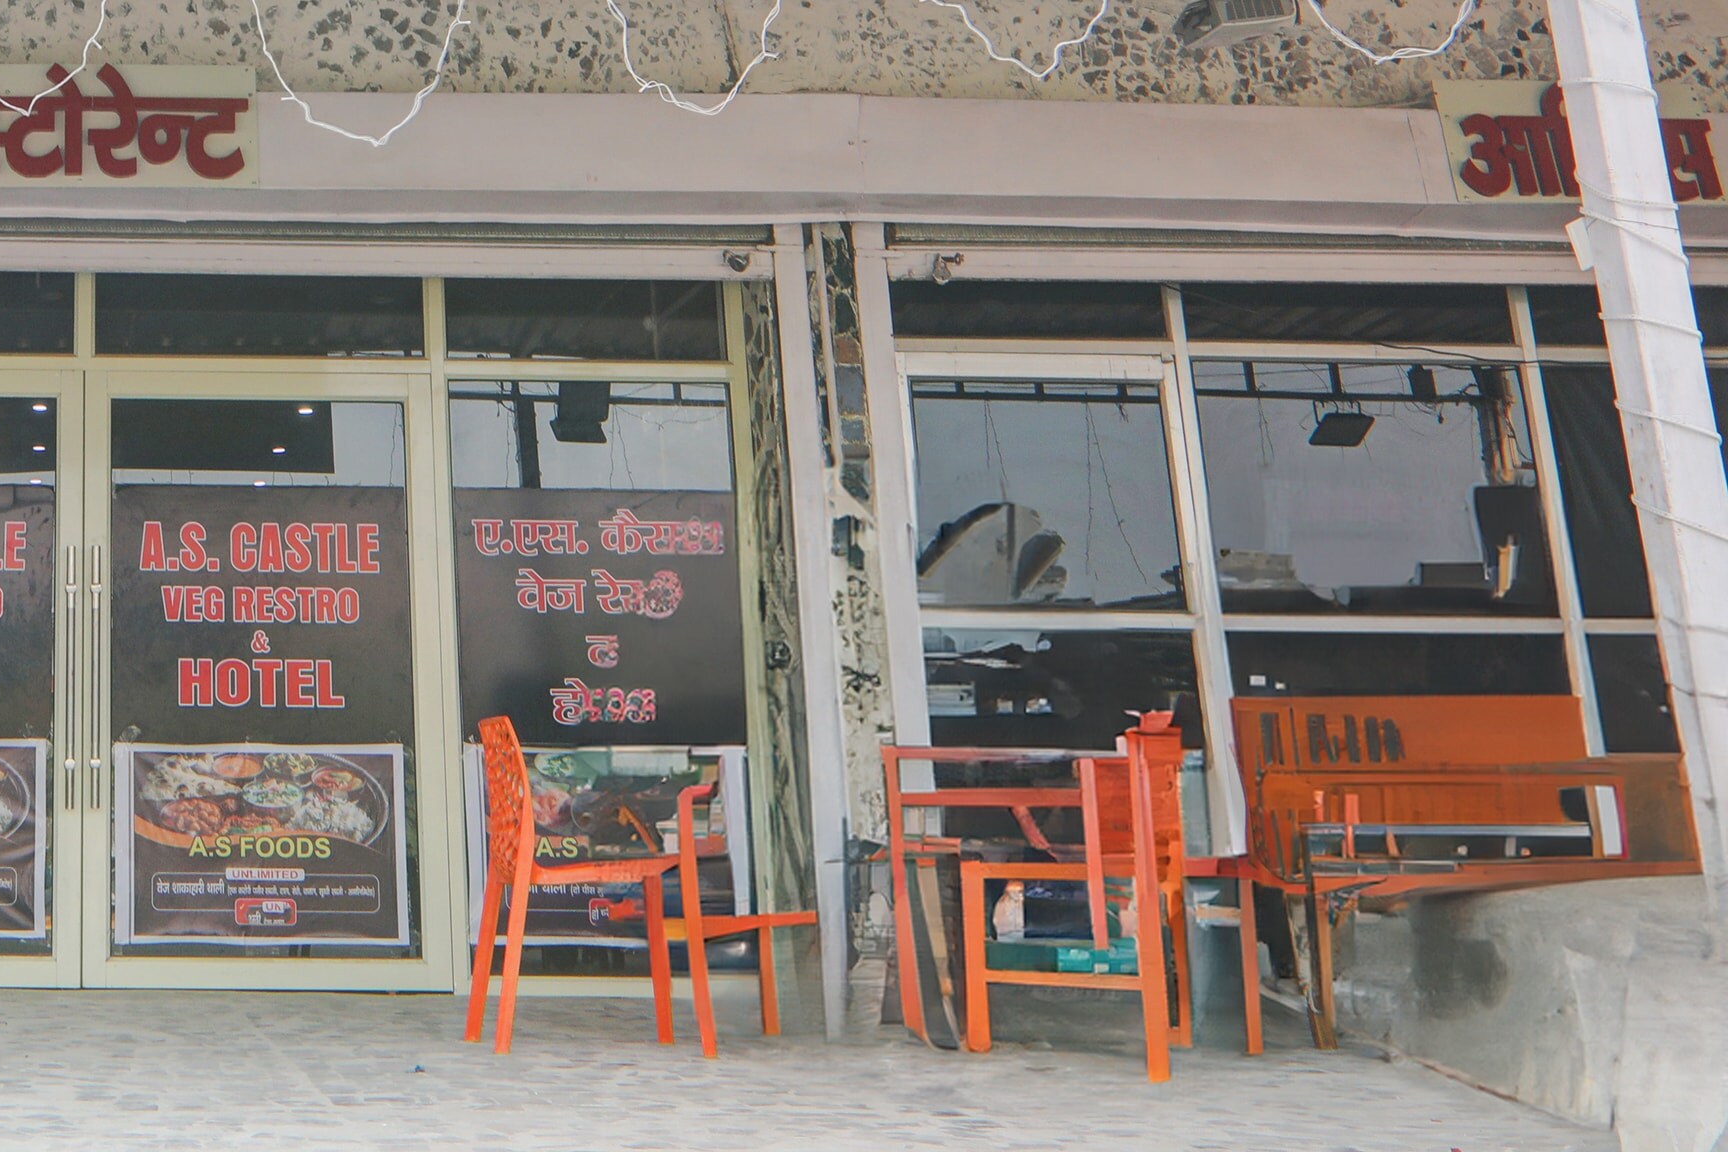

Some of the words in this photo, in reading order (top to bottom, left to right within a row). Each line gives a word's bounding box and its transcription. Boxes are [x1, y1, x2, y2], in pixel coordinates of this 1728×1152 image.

[139, 521, 220, 572] A.S.
[229, 521, 381, 574] CASTLE
[471, 518, 589, 556] ए.एस.
[161, 585, 226, 623] VEG
[232, 586, 360, 624] RESTRO
[514, 568, 586, 614] वेज
[250, 629, 271, 654] &
[177, 658, 346, 708] HOTEL
[188, 836, 232, 858] A.S
[240, 836, 332, 859] FOODS
[535, 836, 579, 859] A.S
[156, 878, 170, 895] वेज
[206, 878, 225, 896] थाली
[232, 869, 299, 880] UNLIMITED
